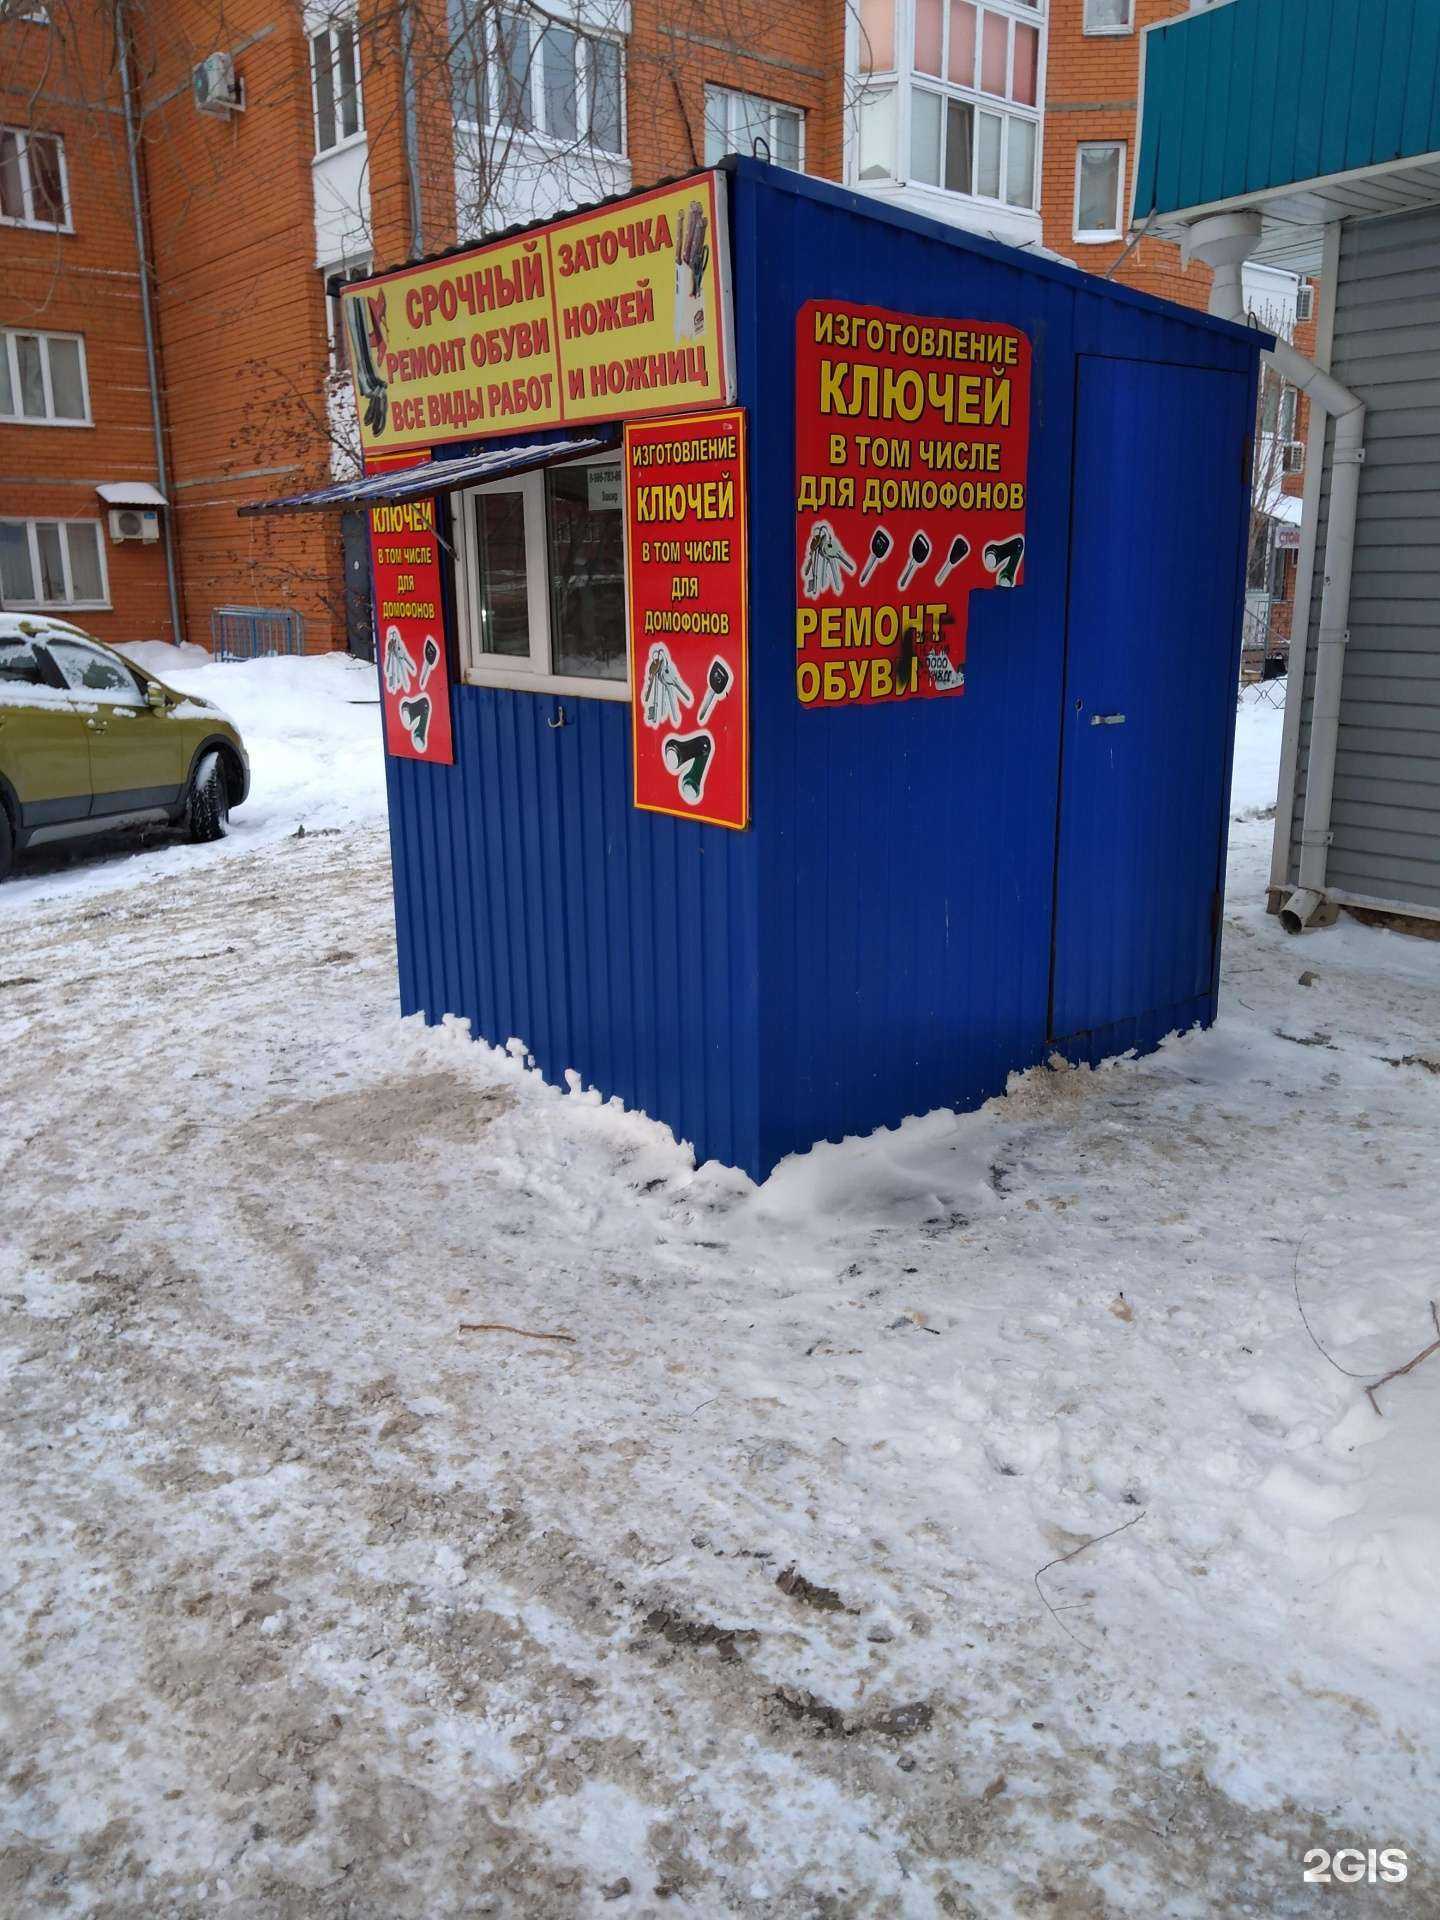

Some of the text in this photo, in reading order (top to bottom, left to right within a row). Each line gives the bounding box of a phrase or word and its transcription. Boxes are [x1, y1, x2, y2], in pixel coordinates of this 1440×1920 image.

[558, 214, 673, 277] ЗАТОЧКА
[406, 241, 545, 330] СРОЧНЫЙ
[563, 279, 654, 340] НОЖЕЙ
[385, 318, 550, 384] РЕМОНТ ОБУВИ
[814, 310, 1018, 365] ИЗГОТОВЛЕНИЕ
[568, 346, 709, 400] И НОЖНИЦ
[820, 360, 1011, 426] КЛЮЧЕЙ
[392, 374, 553, 432] ВСЕ ВИДЫ РАБОТ
[632, 436, 736, 467] ИЗГОТОВЛЕНИЕ
[829, 434, 1000, 471] В ТОМ ЧИСЛЕ
[637, 471, 734, 522] КЛЮЧЕЙ
[797, 475, 1024, 513] ДЛЯ ДОМОФОНОВ
[378, 547, 432, 564] В ТОМ ЧИСЛЕ
[642, 540, 730, 562] В ТОМ ЧИСЛЕ
[397, 575, 415, 594] ДЛЯ
[672, 577, 698, 600] ДЛЯ
[383, 601, 435, 620] ДОМОФОНОВ
[645, 610, 730, 634] ДОМОФОНОВ
[796, 604, 947, 649] РЕМОНТ
